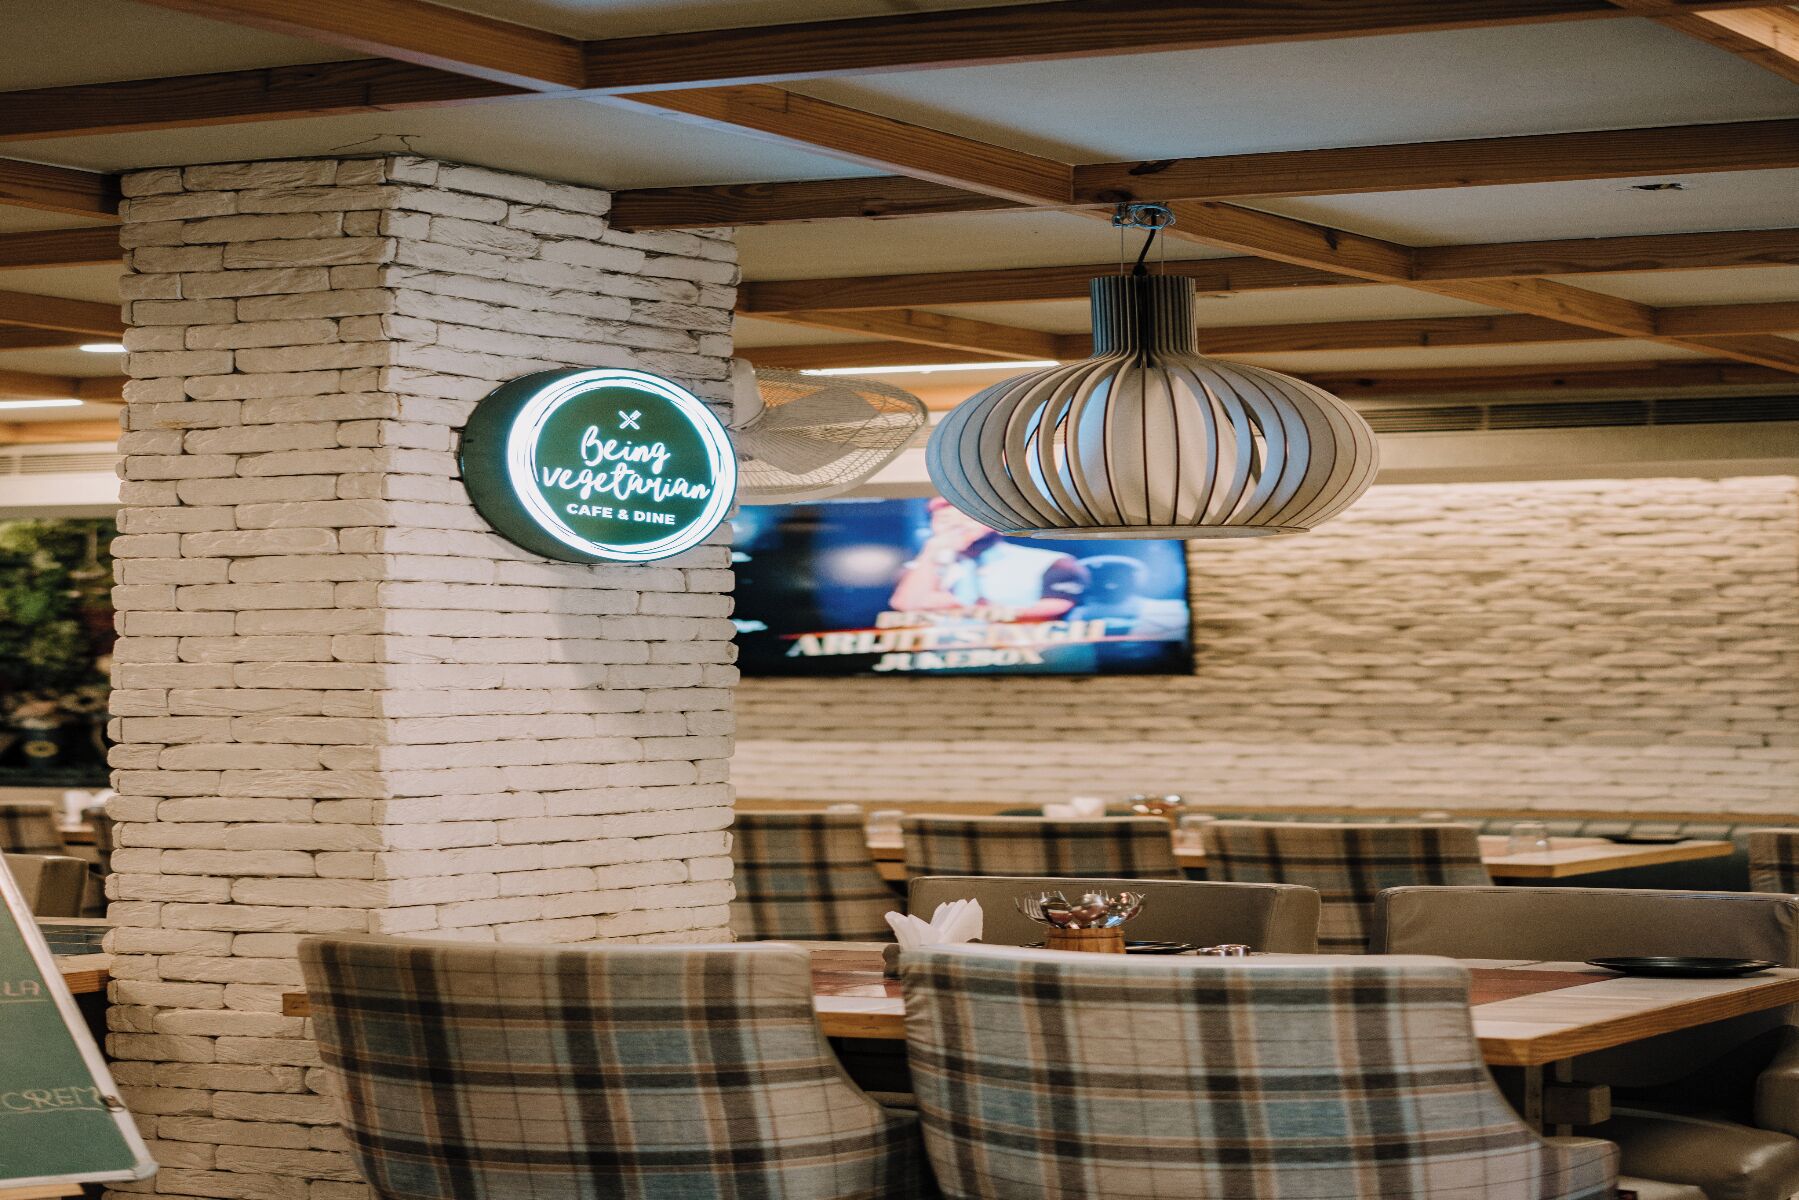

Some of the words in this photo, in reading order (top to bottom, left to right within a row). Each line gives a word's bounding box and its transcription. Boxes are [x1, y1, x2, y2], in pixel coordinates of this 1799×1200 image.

[580, 425, 671, 474] Being
[543, 462, 711, 502] vegetarian
[566, 503, 613, 519] CAFE
[617, 509, 630, 520] &
[633, 510, 676, 525] DINE
